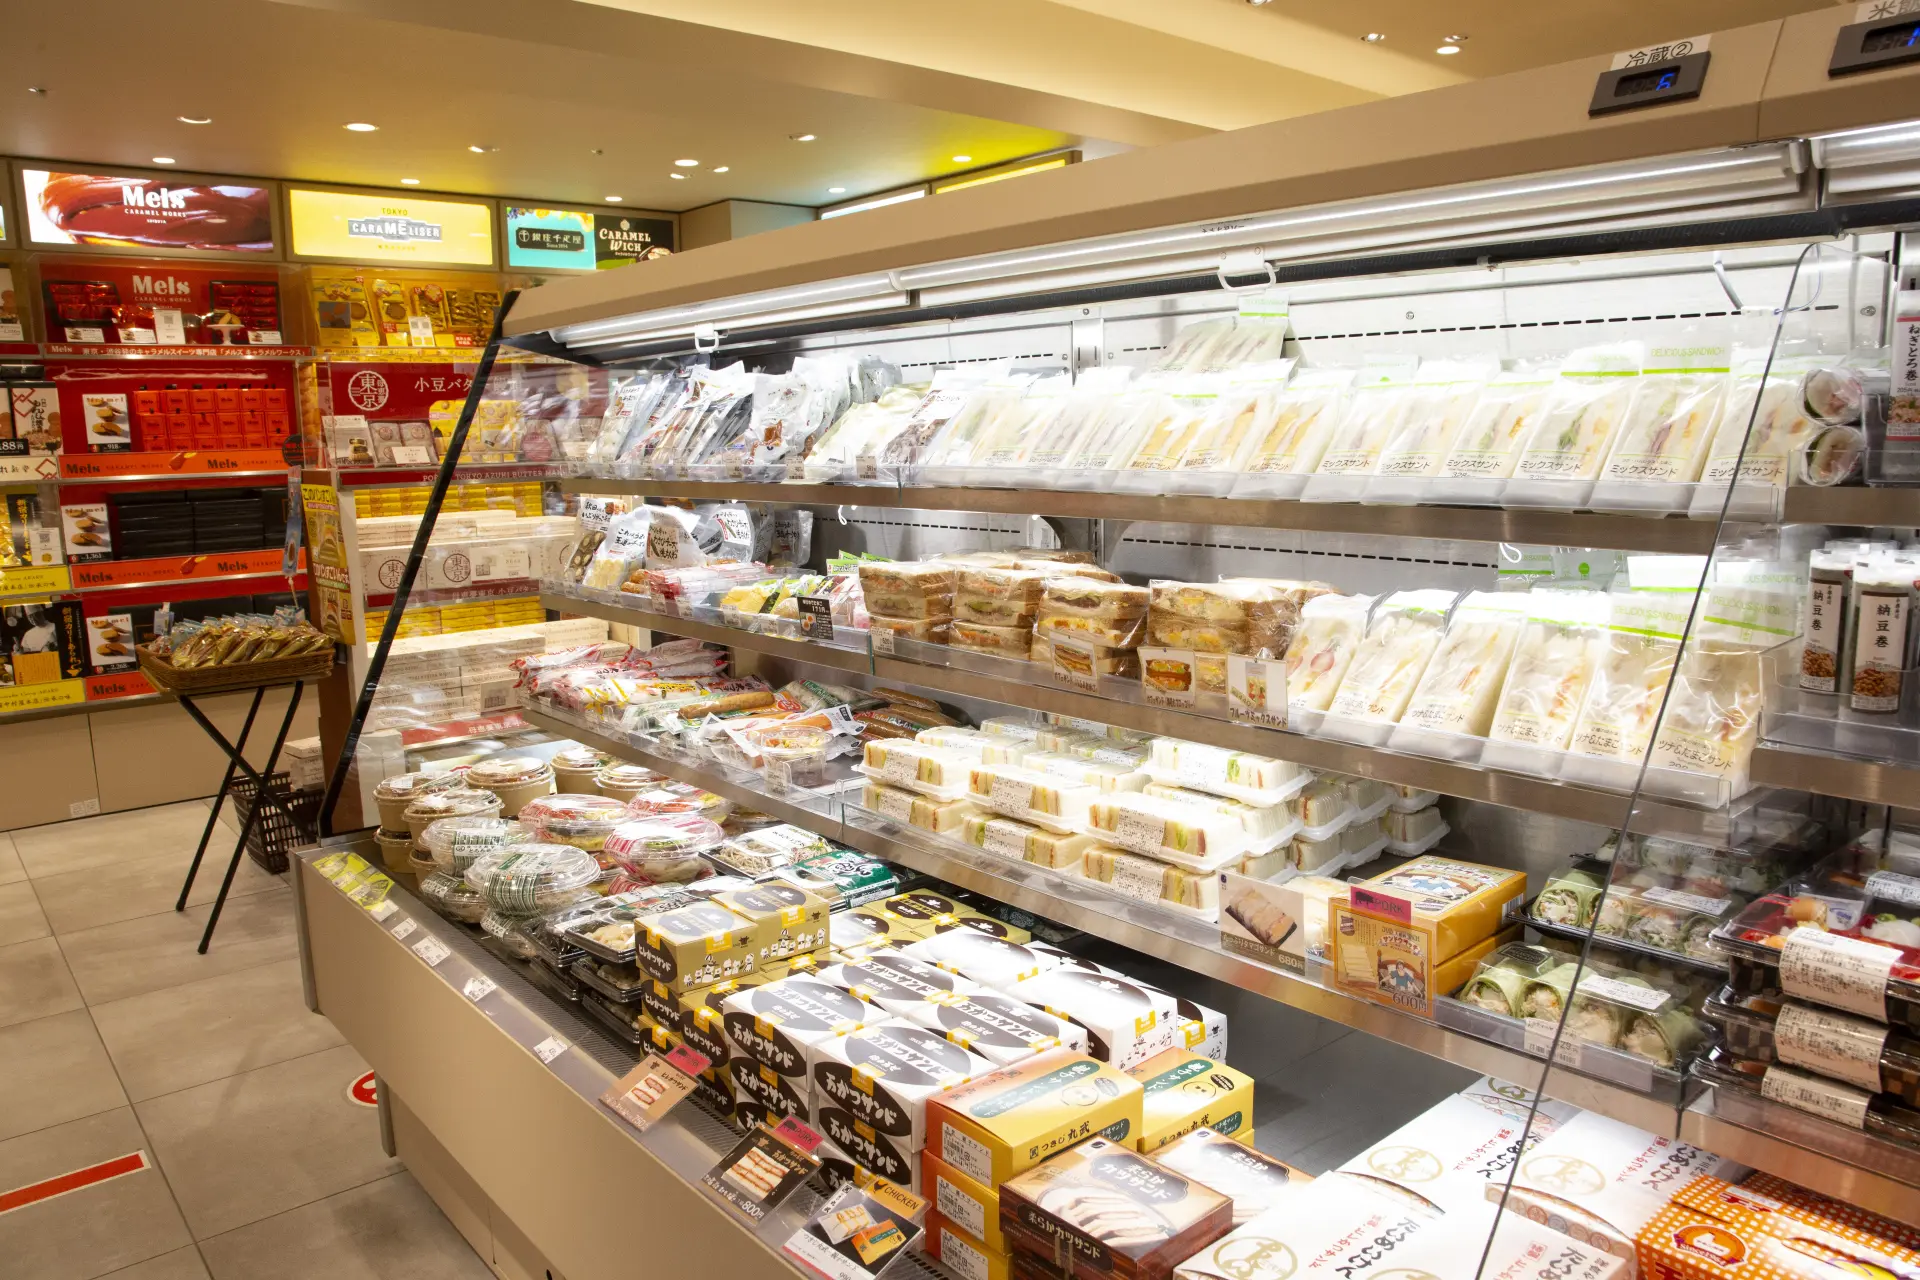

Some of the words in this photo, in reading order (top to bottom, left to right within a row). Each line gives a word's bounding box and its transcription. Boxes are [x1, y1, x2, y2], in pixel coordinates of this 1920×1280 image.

[1625, 41, 1693, 68] 冷蔵②
[122, 185, 186, 209] Mels
[124, 208, 160, 216] CARAMEL
[381, 207, 408, 216] TOKYO
[599, 228, 651, 242] CARAMEL
[609, 239, 642, 252] WICH
[132, 275, 190, 295] Mels
[51, 345, 73, 353] Mels
[66, 463, 101, 474] Mels
[207, 459, 238, 469] Mels
[455, 473, 483, 481] TOKYO
[512, 470, 543, 478] BUTTER
[1446, 459, 1502, 470] ミックスサンド
[1520, 459, 1582, 472] ミックスサンド
[1610, 462, 1678, 478] ミックスサンド
[79, 571, 113, 583] Mels
[217, 561, 248, 572] Mels
[1811, 589, 1824, 631] 納豆巻
[1874, 603, 1891, 648] 納豆巻
[92, 683, 126, 695] Mels
[1659, 740, 1734, 771] ツナ&たまごサンド
[861, 961, 938, 996] 万かつサンド
[959, 1001, 1039, 1040] 万かつサンド
[683, 1025, 723, 1057] ヒレかつサンド
[733, 1021, 795, 1070] 万かつサンド
[869, 1036, 949, 1076] 万かつサンド
[740, 1066, 798, 1115] 万かつサンド
[826, 1071, 898, 1126] 万かつサンド
[830, 1116, 898, 1175] 万かつサンド
[1128, 1163, 1168, 1186] 柔らか
[1642, 1143, 1703, 1191] いめいけん
[1099, 1163, 1173, 1202] カツサンド
[741, 1200, 765, 1219] 800円
[884, 1186, 920, 1211] CHICKEN
[1027, 1210, 1101, 1261] 柔らかカツサンド
[1335, 1215, 1422, 1280] たいめいけん
